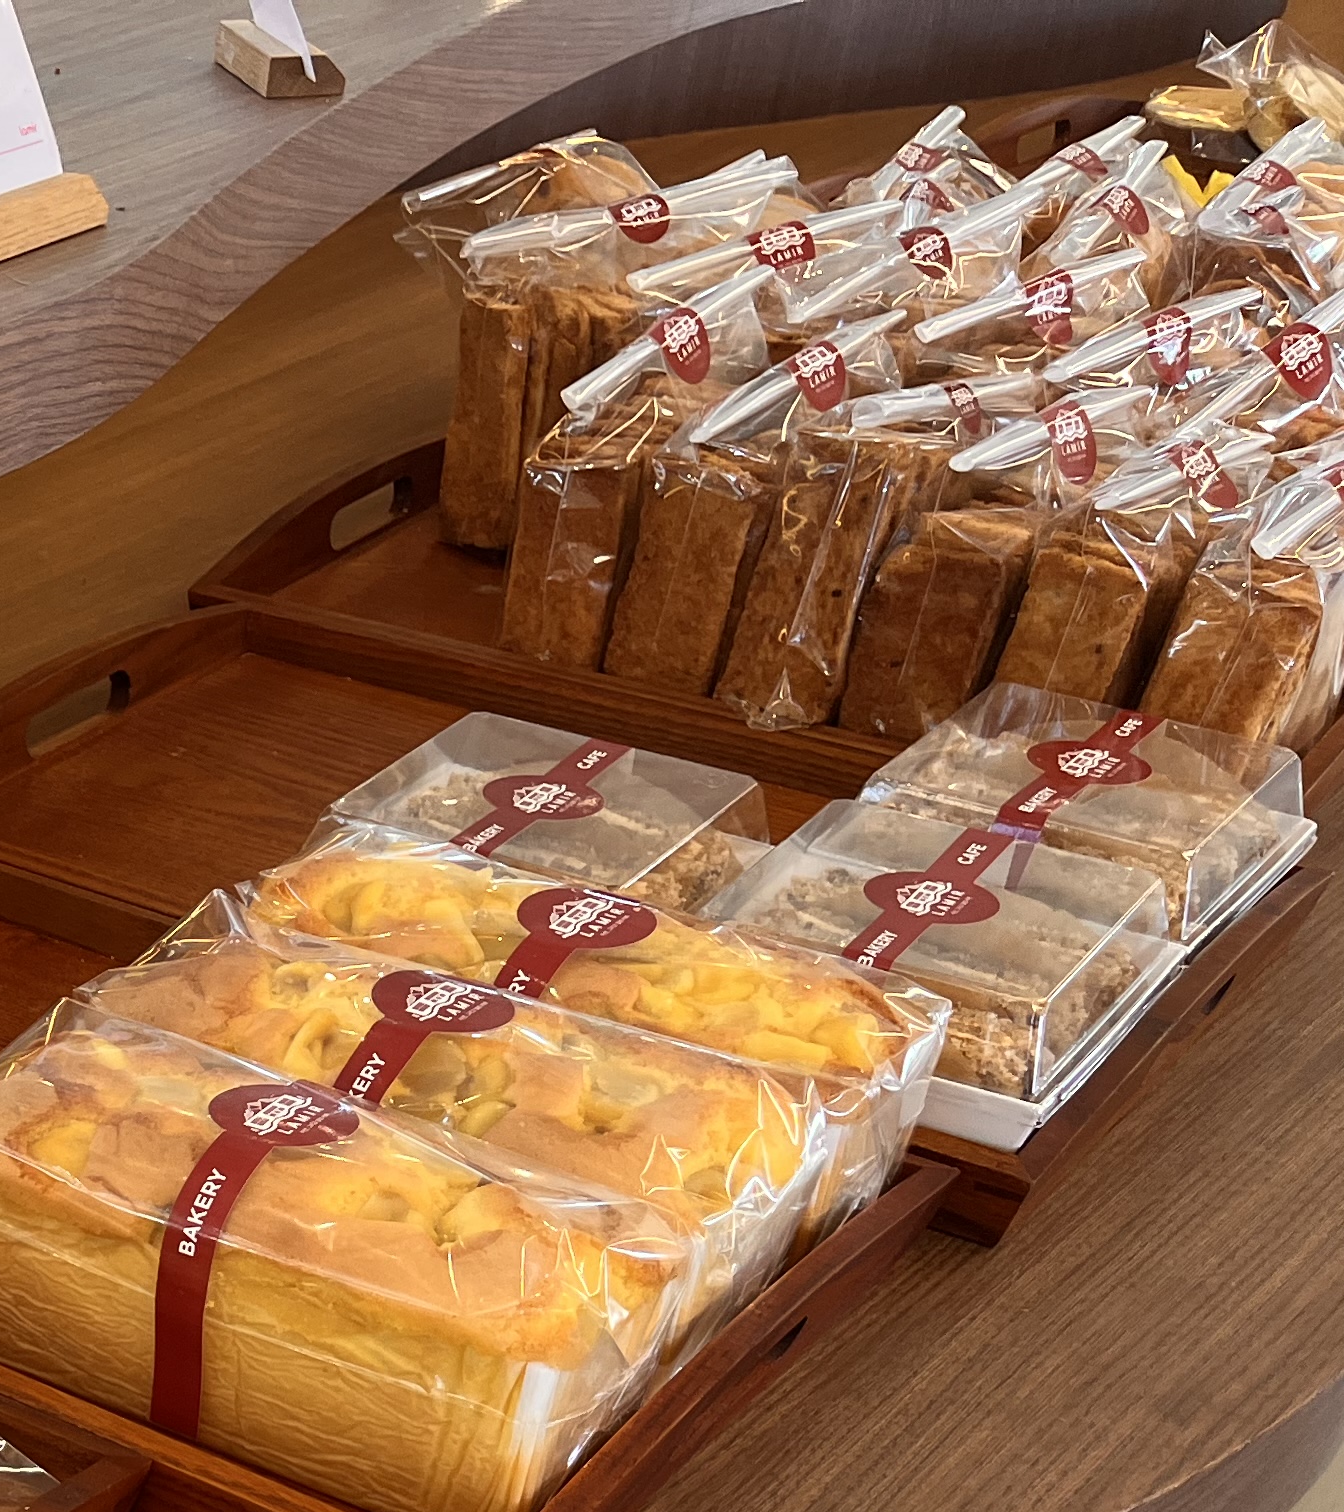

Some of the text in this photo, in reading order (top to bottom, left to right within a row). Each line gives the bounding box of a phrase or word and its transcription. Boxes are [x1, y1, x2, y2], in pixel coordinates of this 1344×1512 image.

[770, 246, 804, 264] LAMIR
[676, 336, 701, 362] LAMIR
[808, 366, 837, 388] LAMIR
[1295, 353, 1324, 380] LAMIR
[1061, 440, 1087, 457] LAMIR
[1114, 718, 1143, 737] CAFE
[576, 749, 608, 770] CAFE
[541, 790, 577, 814] LAMIR
[1017, 786, 1058, 813] BAKERY
[462, 823, 505, 853] BAKERY
[956, 842, 988, 866] CAFE
[930, 890, 966, 917] LAMIR
[579, 907, 625, 938] LAMIR
[857, 929, 899, 968] BAKERY
[437, 992, 485, 1022] LAMIR
[347, 1052, 386, 1100] KERY
[278, 1106, 325, 1135] LAMIR
[178, 1167, 227, 1257] BAKERY
